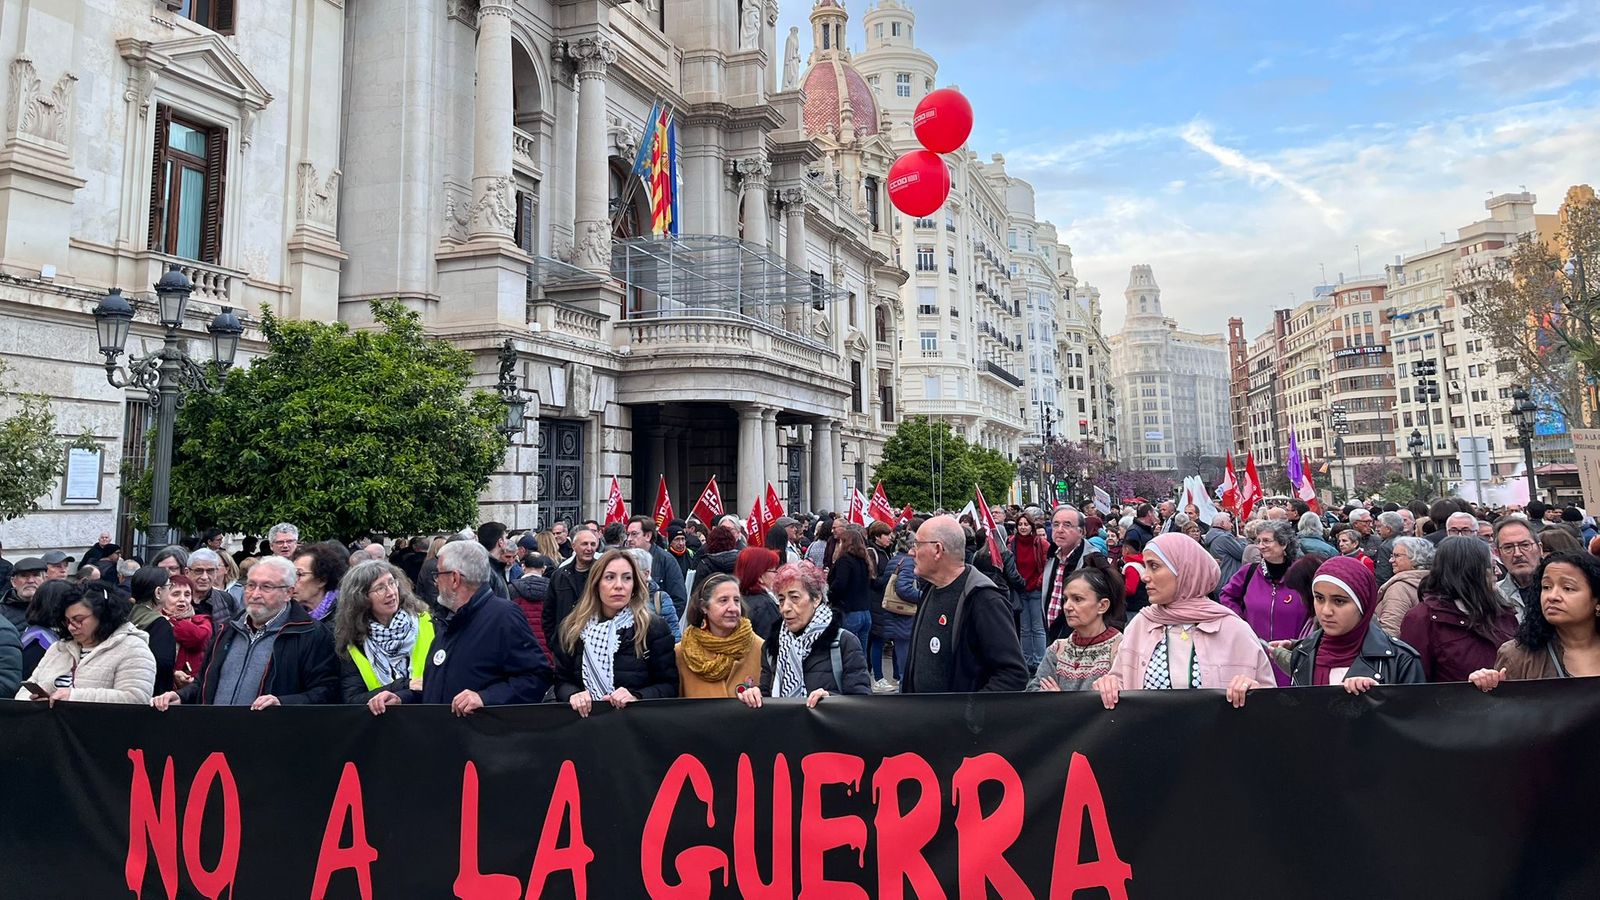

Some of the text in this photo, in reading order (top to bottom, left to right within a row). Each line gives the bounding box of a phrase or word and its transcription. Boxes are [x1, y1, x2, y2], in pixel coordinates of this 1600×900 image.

[1573, 433, 1583, 441] NO
[126, 749, 1133, 900] NO A LA GUERRA
